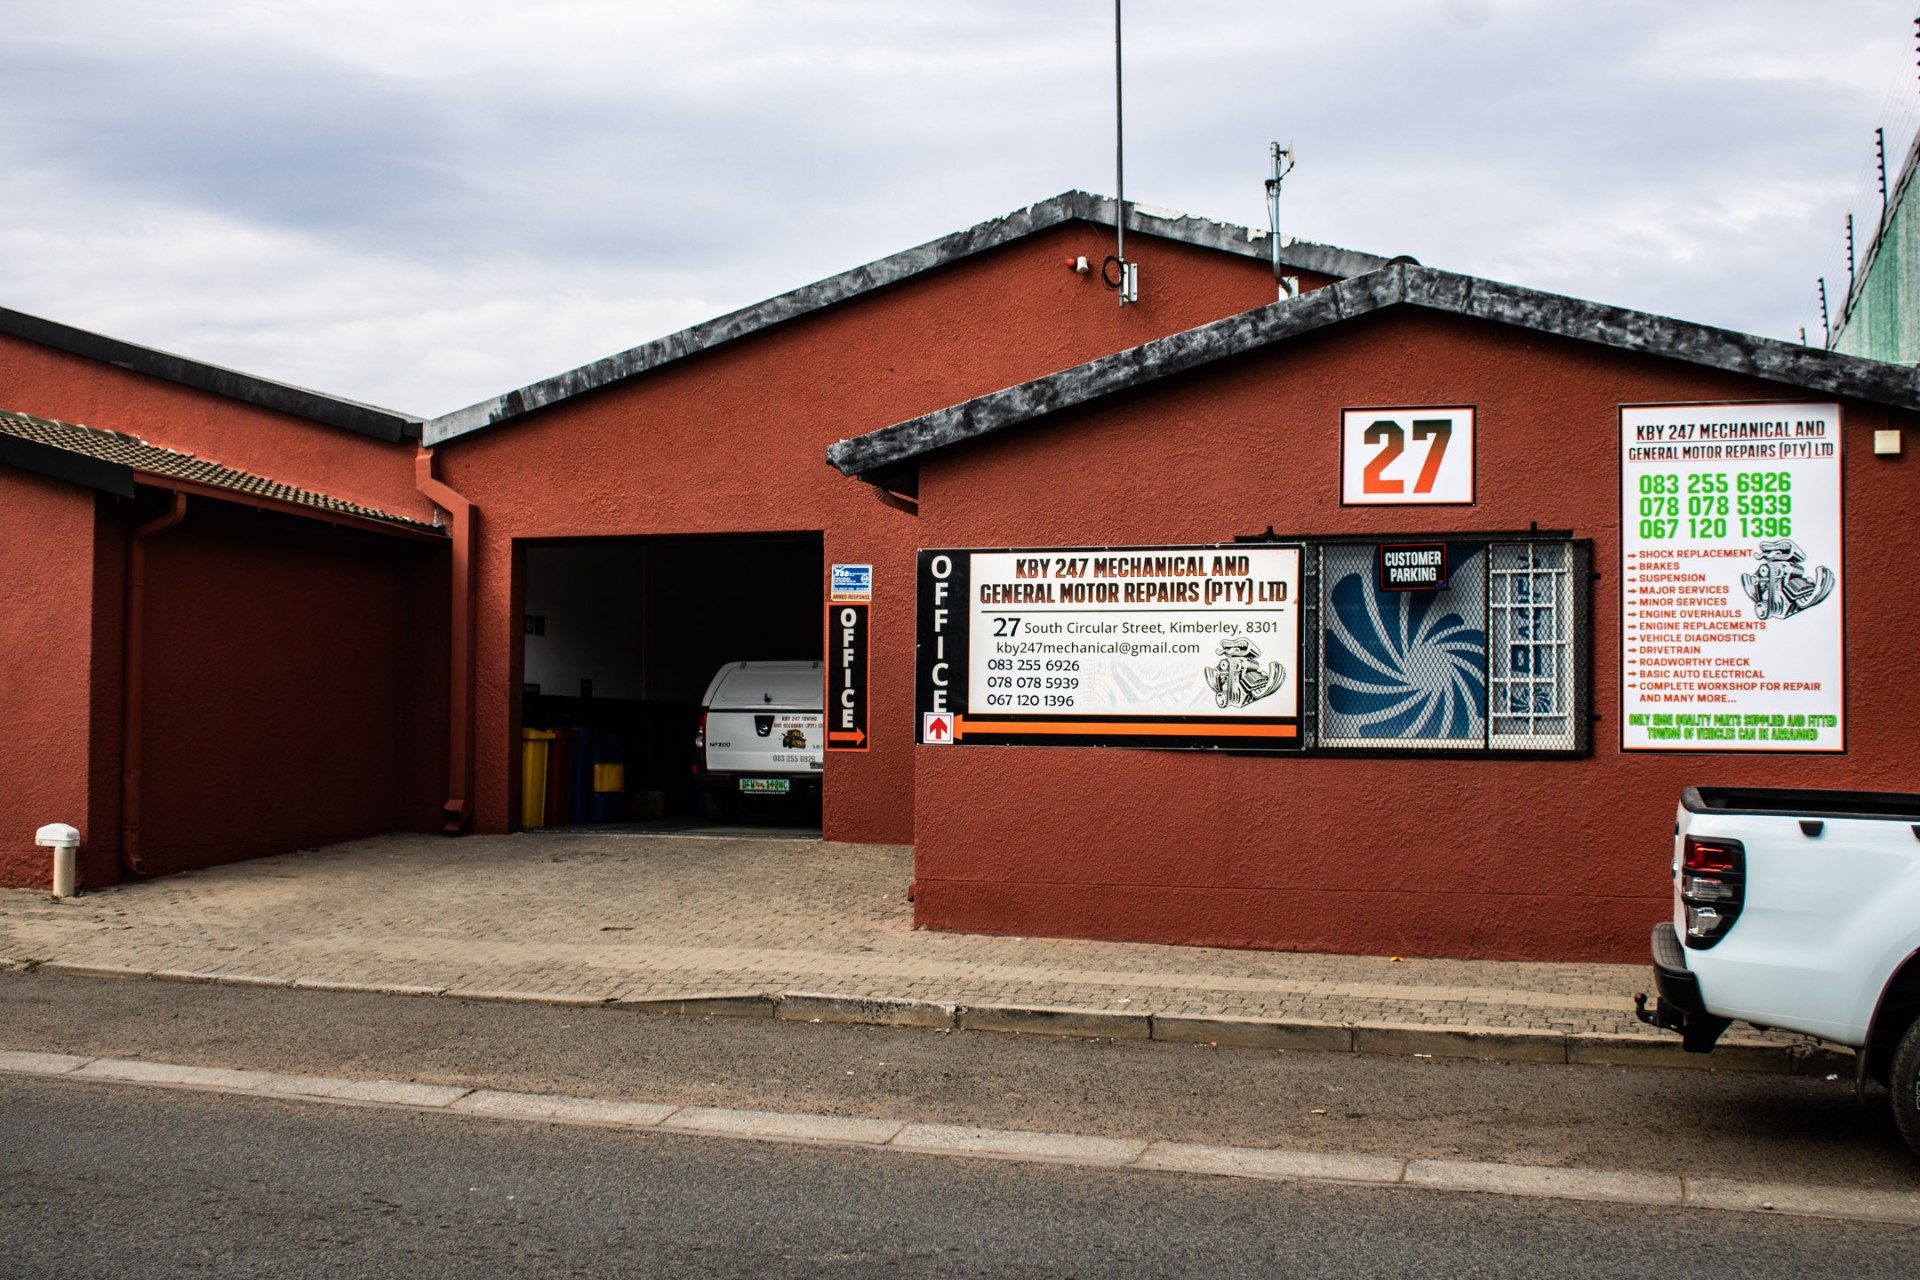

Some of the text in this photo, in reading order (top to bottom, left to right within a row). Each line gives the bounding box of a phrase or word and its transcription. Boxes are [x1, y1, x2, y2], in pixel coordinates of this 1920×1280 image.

[1636, 421, 1825, 441] KBY 247 MECHANICAL AND
[1363, 418, 1453, 494] 27
[1629, 442, 1833, 461] GENERAL MOTOR REPAIRS (PTY) LTD
[1639, 472, 1792, 495] 083 255 6926
[1639, 495, 1792, 517] 078 078 5939
[1639, 517, 1792, 539] 067 120 1396
[1385, 551, 1441, 566] CUSTOMER
[1639, 549, 1753, 559] SHOCK REPLACEMENT
[1016, 555, 1250, 579] KBY 247 MECHANICAL AND
[1639, 562, 1680, 570] BRAKES
[1390, 567, 1436, 582] PARKING
[1639, 574, 1706, 583] SUSPENSION
[980, 578, 1288, 605] GENERAL MOTOR REPAIRS (PTY) LTD
[1639, 585, 1729, 594] MAJOR SERVICES
[1639, 598, 1727, 606] MINOR SERVICES
[1639, 610, 1741, 619] ENGINE OVERHAULS
[992, 618, 1278, 638] 27 South Circular Street, Kimberley, 8301
[1639, 622, 1766, 630] ENIGINE REPLACEMENTS
[931, 555, 951, 712] OFFICE
[1639, 634, 1756, 642] VEHICLE DIAGNOSTICS
[996, 641, 1200, 656] kby247mechanical@gmail.com
[1639, 646, 1701, 654] DRIVETRAIN
[840, 608, 857, 728] OFFICE
[987, 659, 1080, 672] 083 255 6926
[1639, 658, 1750, 666] ROADWORTHY CHECK
[1639, 670, 1765, 678] BASIC AUTO ELECTRICAL
[987, 677, 1079, 689] 078 078 5939
[1639, 682, 1695, 690] COMPLETE
[1697, 682, 1758, 690] WORKSHOP
[1783, 683, 1821, 691] REPAIR
[987, 694, 1074, 707] 067 120 1396
[1639, 694, 1737, 702] AND MANY MORE...
[1676, 713, 1712, 728] QUALITY
[1714, 713, 1741, 726] PARTS
